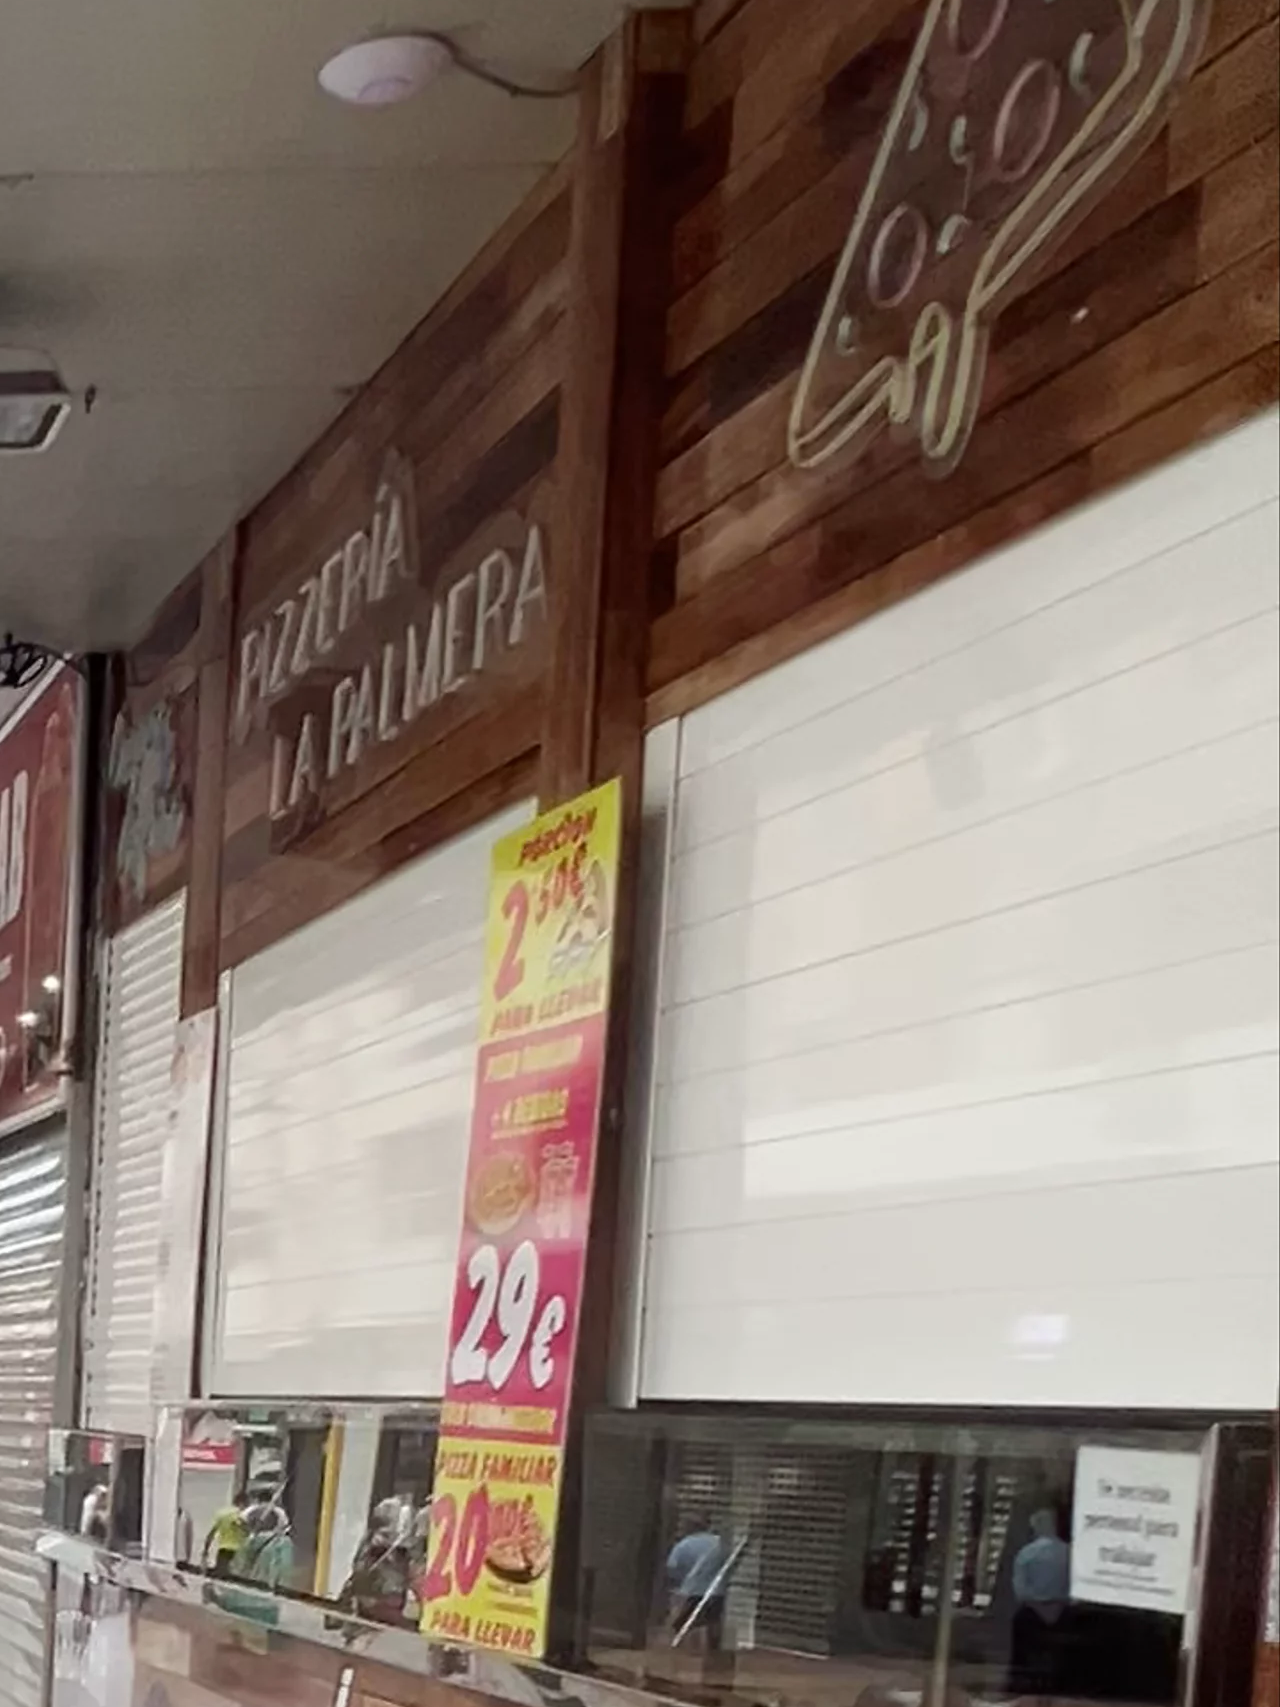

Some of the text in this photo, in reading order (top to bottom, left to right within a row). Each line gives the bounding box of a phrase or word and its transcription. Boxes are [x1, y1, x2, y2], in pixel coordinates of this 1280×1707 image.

[237, 483, 406, 727] PIZZERÍA
[269, 525, 548, 821] LA PALMERA
[482, 1453, 558, 1488] FAMILIAR
[474, 1618, 537, 1651] LLEVAR
